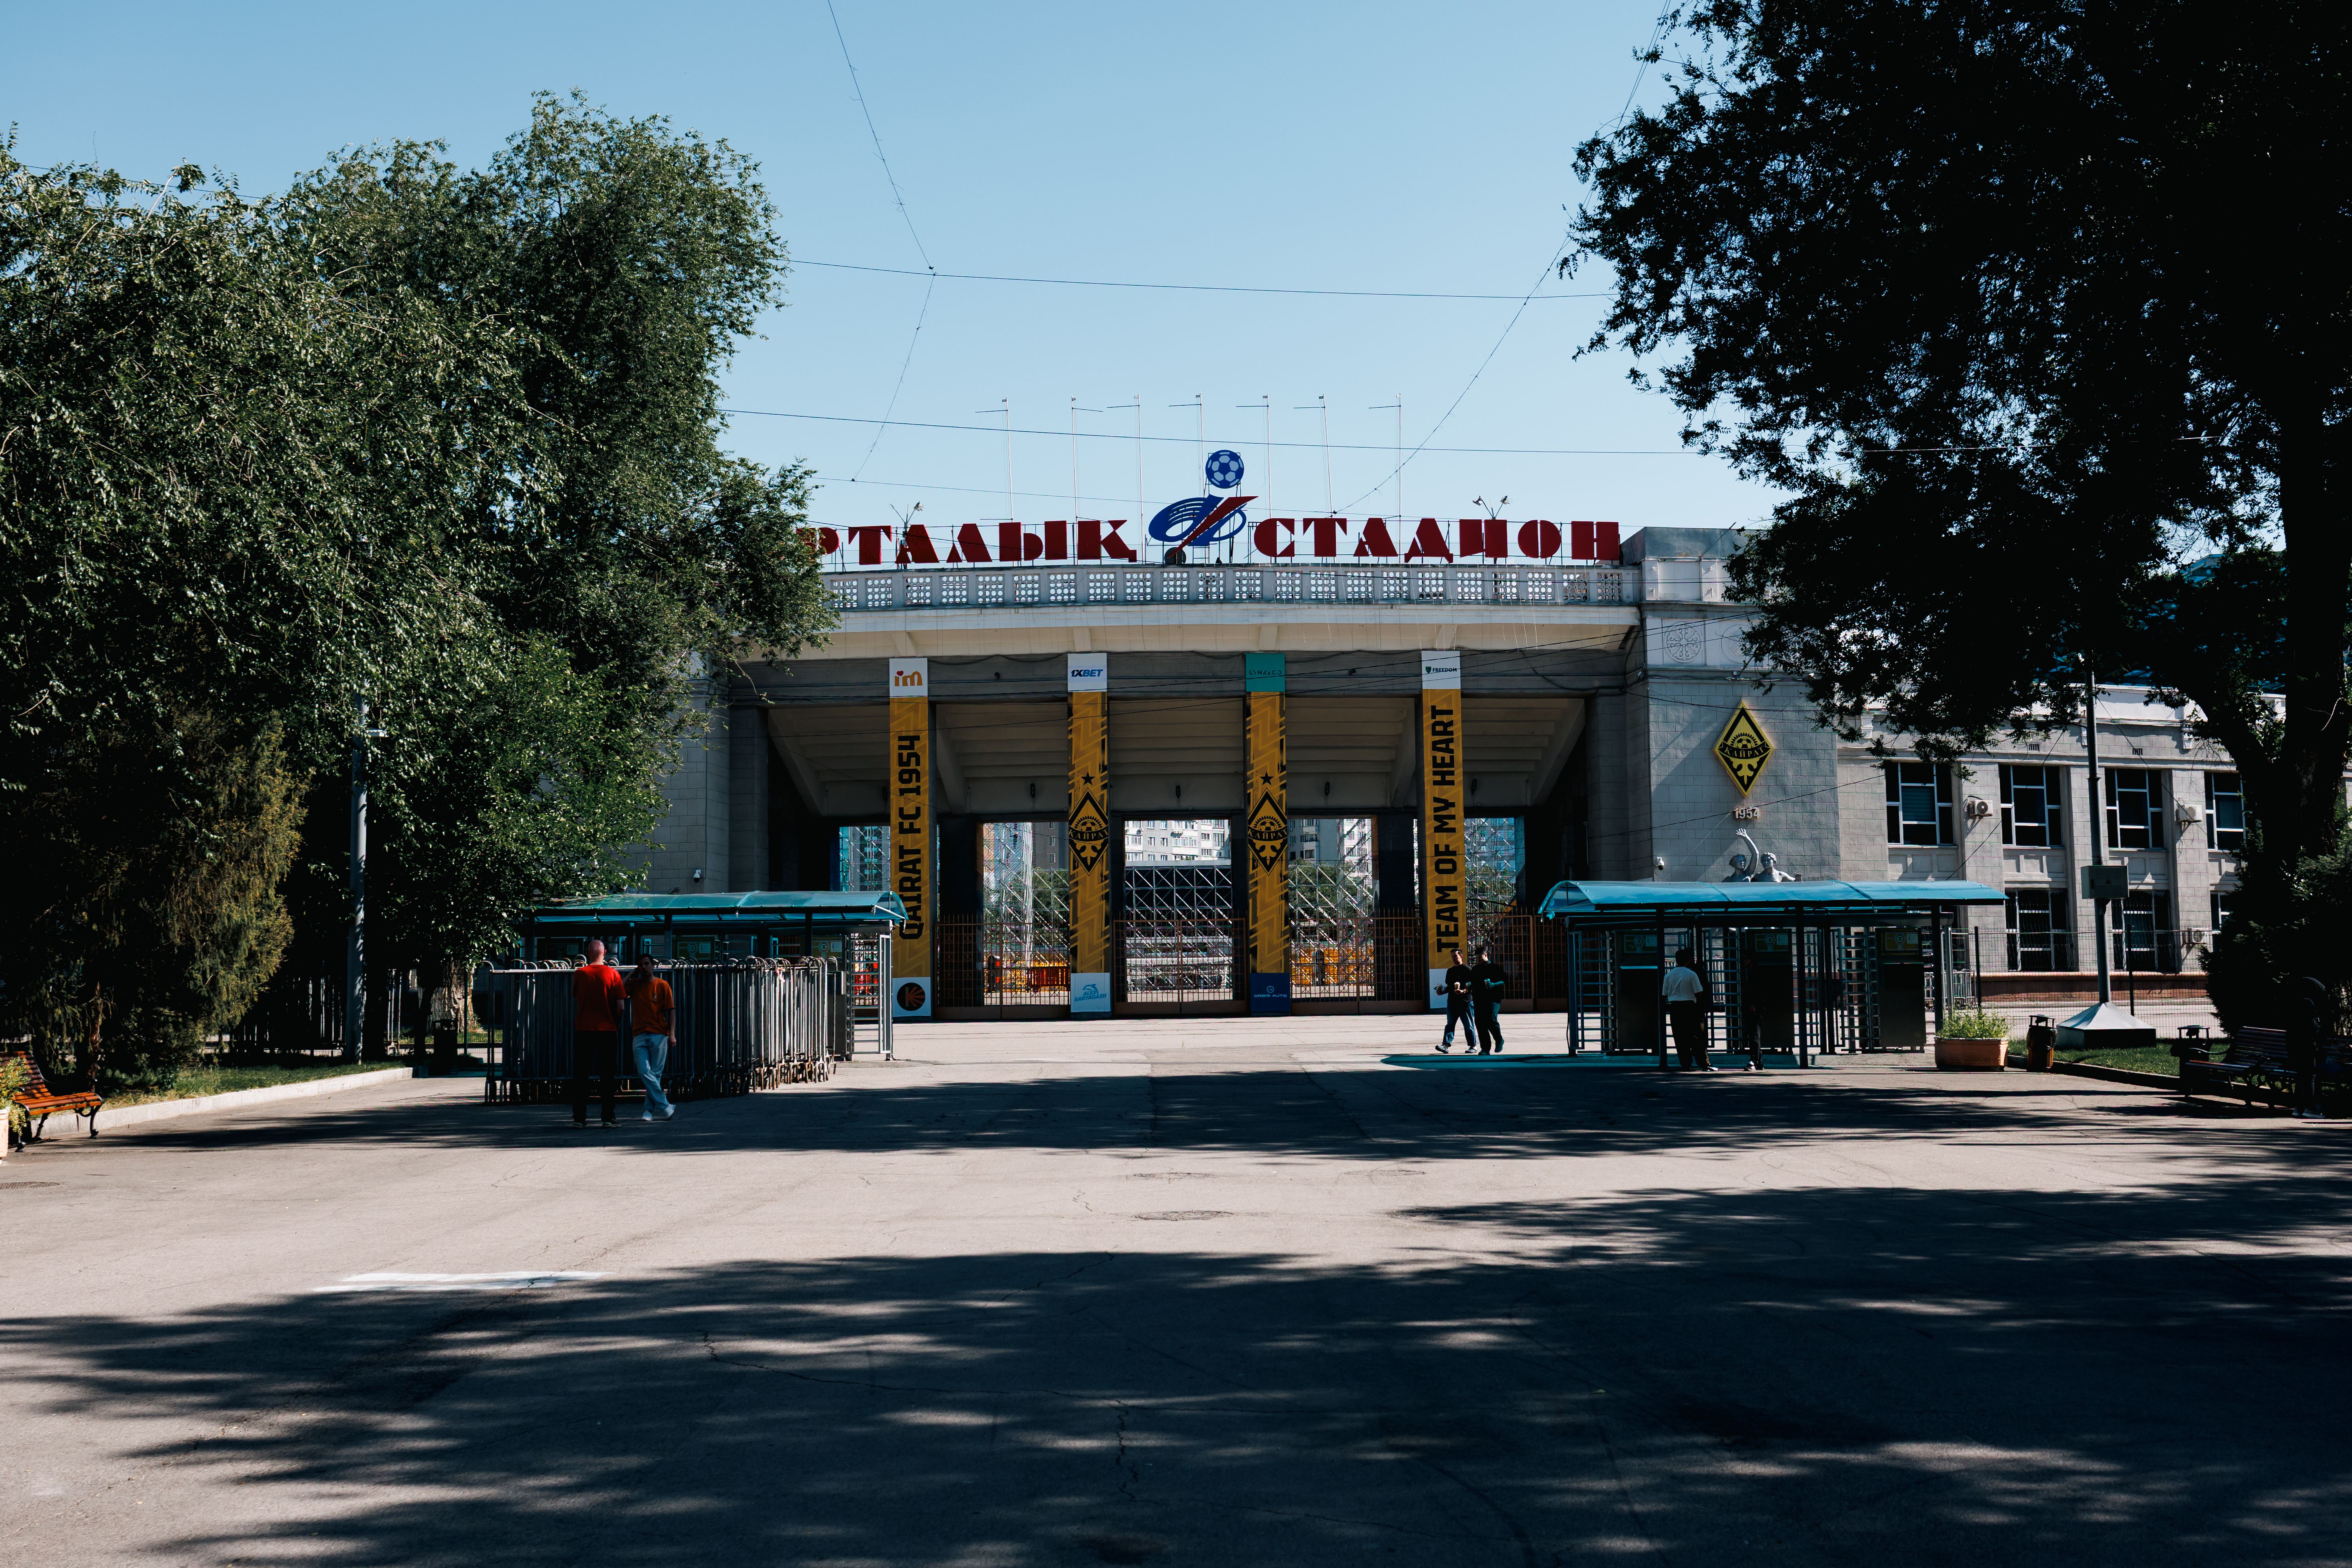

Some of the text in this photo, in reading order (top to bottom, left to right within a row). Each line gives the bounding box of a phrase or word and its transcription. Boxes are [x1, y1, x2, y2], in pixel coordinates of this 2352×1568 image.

[796, 518, 1620, 565] РТАЛЫҚ СТАДИОН
[1071, 669, 1103, 677] 1XBET
[1431, 705, 1459, 953] TEAM OF MY HEART
[1734, 807, 1760, 819] 1954
[898, 735, 924, 940] QAIRAT FC 1954
